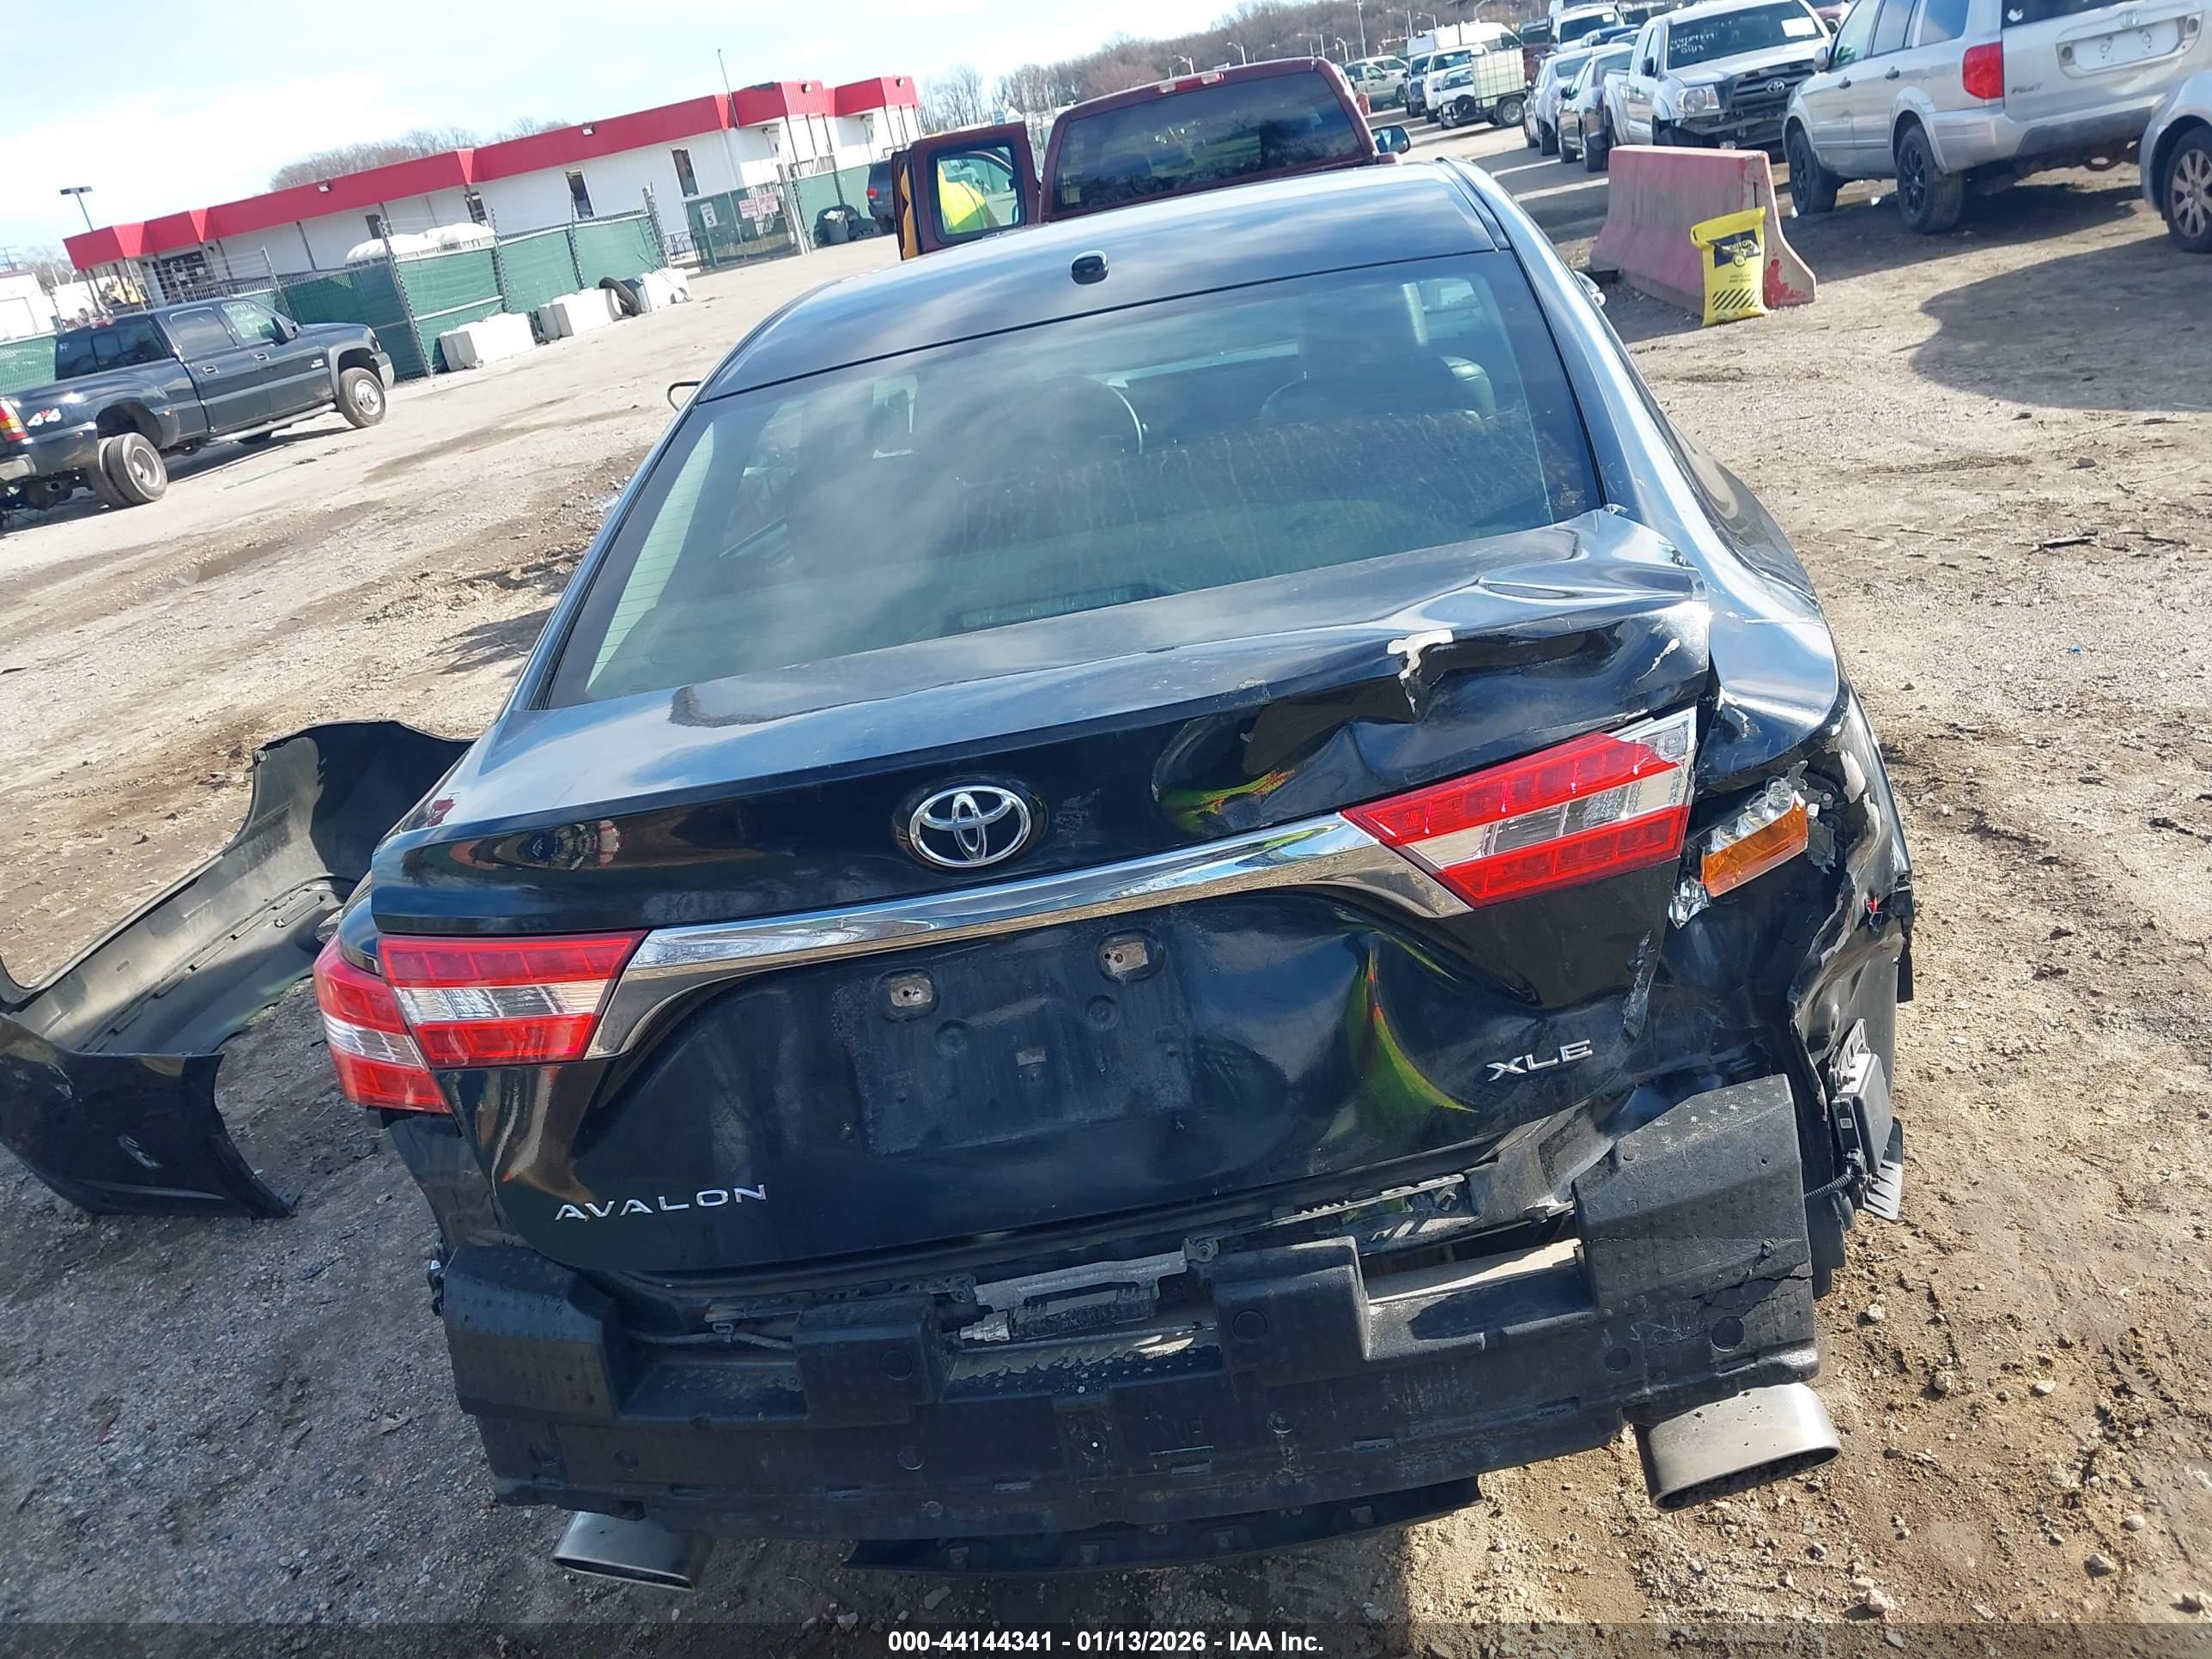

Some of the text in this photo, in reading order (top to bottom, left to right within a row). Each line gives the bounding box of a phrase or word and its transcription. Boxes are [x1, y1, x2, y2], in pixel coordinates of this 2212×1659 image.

[707, 216, 714, 226] 5
[1486, 1039, 1593, 1082] XLE
[555, 1184, 767, 1221] AVALON
